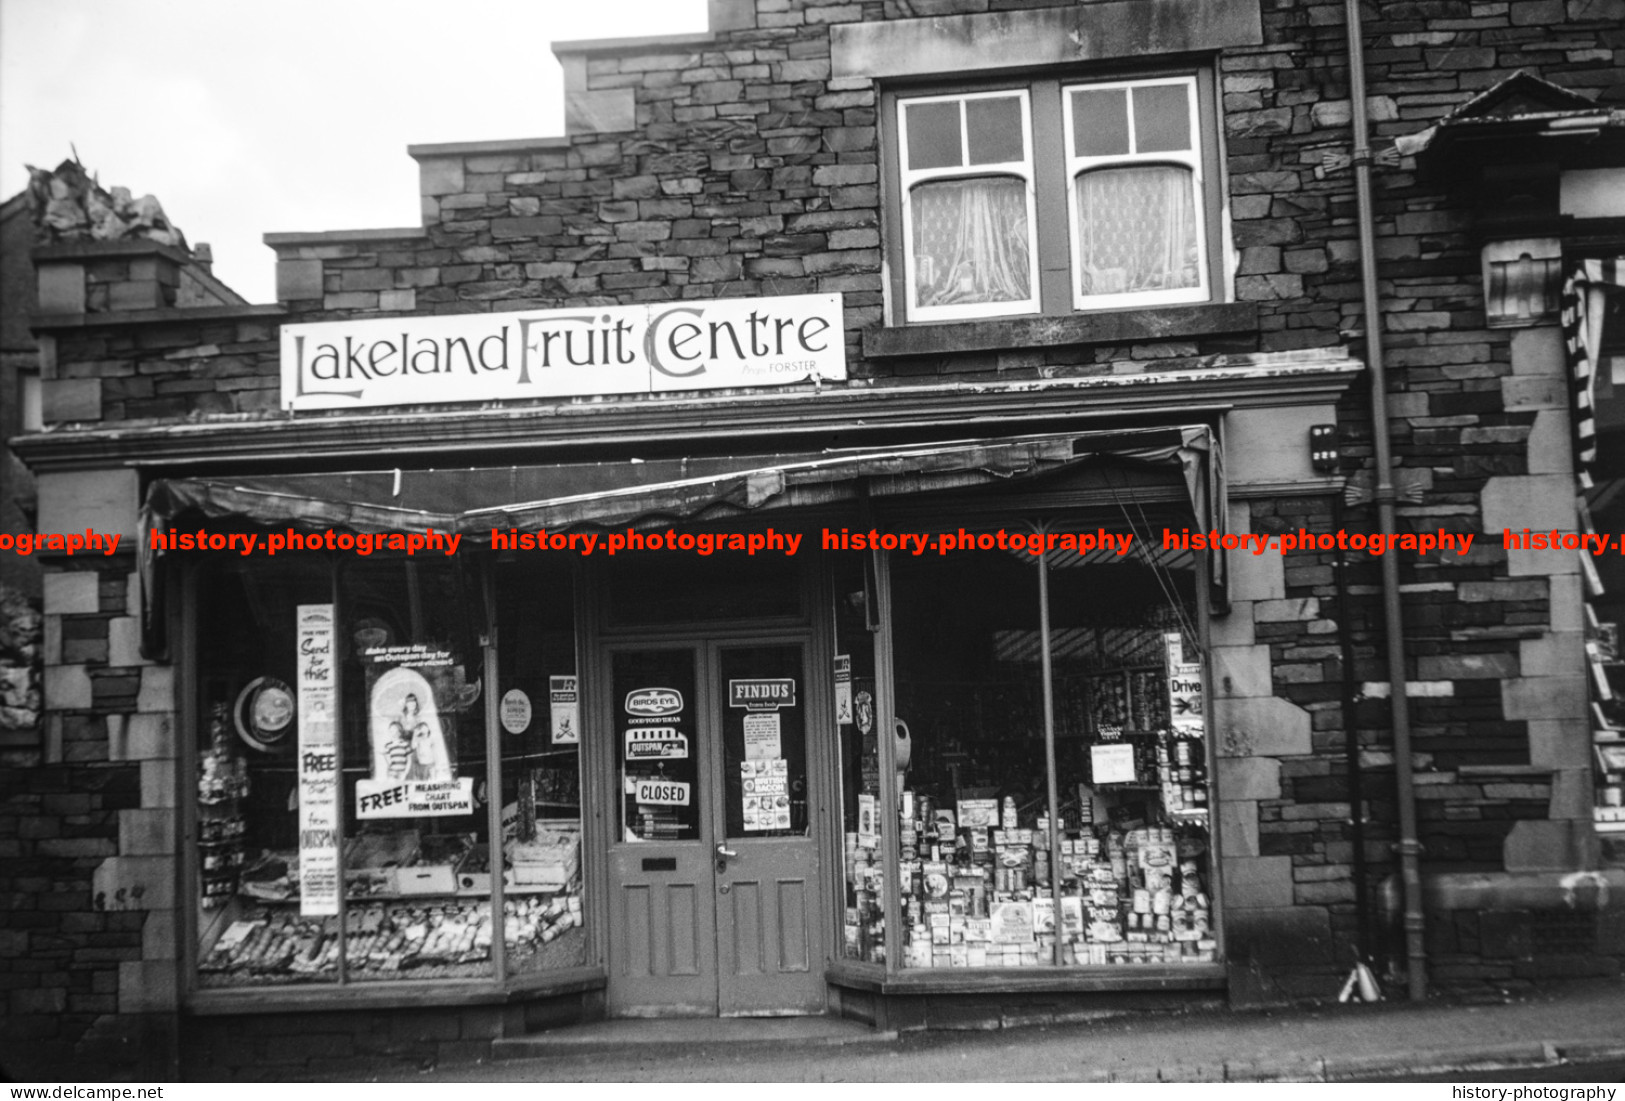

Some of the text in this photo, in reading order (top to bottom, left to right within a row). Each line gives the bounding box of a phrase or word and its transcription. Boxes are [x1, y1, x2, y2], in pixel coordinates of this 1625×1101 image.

[295, 307, 831, 399] Lakeland Fruit Centre
[769, 360, 817, 373] FORSTER
[301, 637, 329, 656] Send
[411, 644, 427, 653] day
[385, 653, 420, 661] Outspan
[420, 652, 436, 660] day
[436, 650, 450, 659] for
[304, 665, 330, 681] this
[735, 684, 789, 699] FINDUS
[1172, 679, 1202, 692] Drive
[633, 697, 675, 706] BIRDS EYE
[631, 742, 663, 752] OUTSPAN
[302, 752, 336, 773] FREE
[415, 782, 461, 792] MEASURING
[641, 785, 685, 801] CLOSED
[360, 784, 409, 813] FREE!
[425, 792, 451, 801] CHART
[409, 801, 469, 812] FROM OUTSPAN
